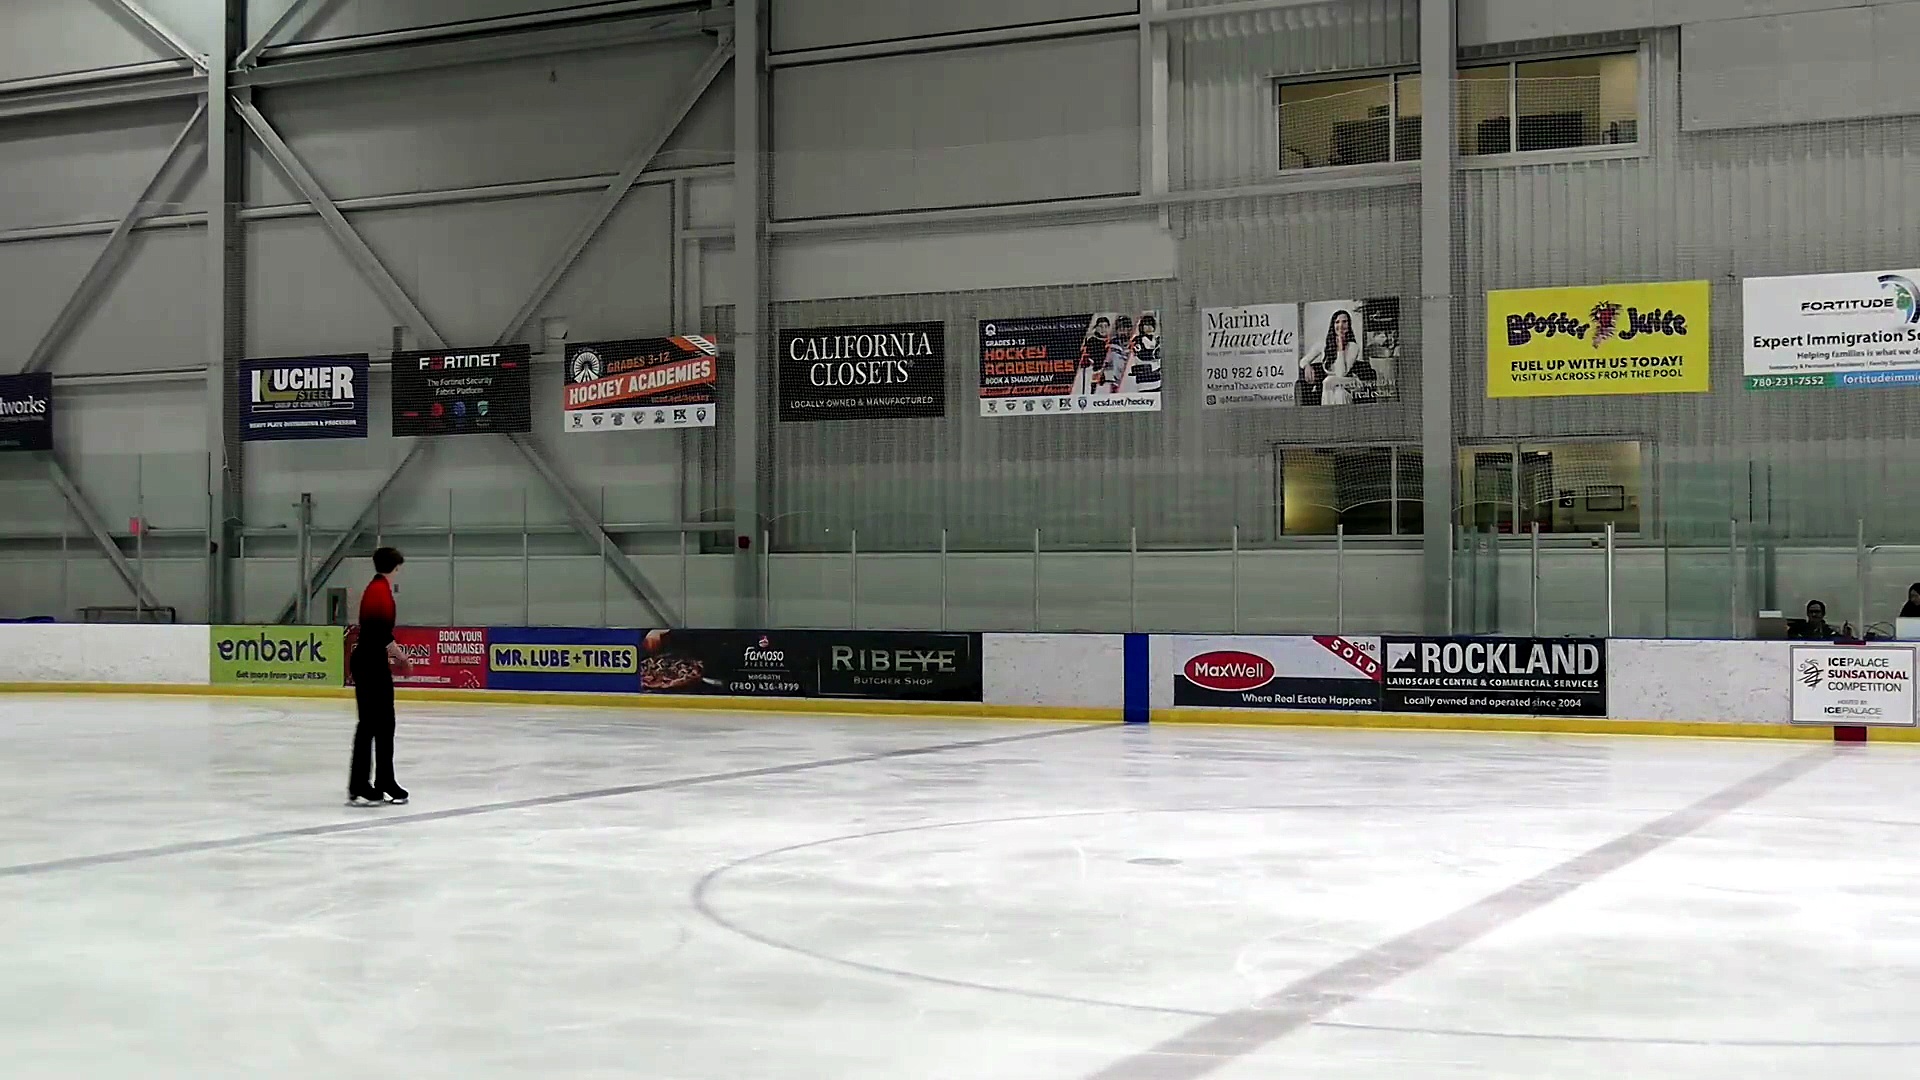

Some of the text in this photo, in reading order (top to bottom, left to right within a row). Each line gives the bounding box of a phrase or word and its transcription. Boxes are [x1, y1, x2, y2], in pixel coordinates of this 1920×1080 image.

[1801, 298, 1894, 311] FORTITUDE
[1208, 310, 1270, 329] Marina
[1507, 307, 1687, 346] Booster Juice
[1208, 329, 1293, 348] Thauvette
[1753, 336, 1803, 349] Expert
[1807, 330, 1903, 346] Immigration
[790, 332, 933, 360] CALIFORNIA
[985, 345, 1048, 360] HOCKEY
[1797, 352, 1829, 360] Helping
[1831, 350, 1865, 358] families
[1876, 348, 1897, 356] what
[419, 353, 501, 370] FORTINET
[607, 351, 671, 373] GRADES 3-12
[985, 360, 1075, 375] ACADEMIES
[1511, 356, 1683, 372] FUEL UP WITH US TODAY!
[1207, 365, 1284, 379] 780 982 6104
[1511, 368, 1683, 382] VISIT US ACROSS FROM THE POOL
[251, 366, 354, 402] KUCHER
[569, 360, 711, 405] HOCKEY ACADEMIES
[986, 376, 1003, 385] BOOK
[1011, 375, 1039, 384] SHADOW
[1040, 374, 1054, 382] DAY
[1752, 374, 1920, 387] 780-231-7552 fortitudeimmi
[298, 390, 331, 400] STEEL
[1093, 397, 1155, 407] ecsd.net/hockey
[791, 400, 824, 409] LOCALLY
[826, 399, 856, 408] OWNED
[866, 396, 933, 406] MANUFACTURED
[439, 631, 482, 642] BOOK YOUR
[217, 632, 327, 662] embark
[437, 643, 484, 654] FUNDRAISER
[1353, 641, 1376, 651] Sale
[441, 655, 447, 663] AT
[495, 648, 527, 666] MR.
[530, 649, 570, 667] LUBE
[582, 650, 632, 668] TIRES
[831, 645, 956, 673] RIBEYE
[1331, 639, 1377, 674] SOLD
[1421, 643, 1599, 675] ROCKLAND
[236, 670, 249, 679] Get
[269, 671, 287, 679] from
[288, 672, 304, 681] your
[1195, 662, 1264, 679] MaxWell
[1828, 670, 1909, 680] SUNSATIONAL
[730, 682, 755, 692] (780)
[1387, 677, 1599, 688] LANDSCAPE CENTRE & COMMERCIAL SERVICES
[1828, 681, 1902, 692] COMPETITION
[1242, 693, 1273, 703] Where
[1274, 693, 1296, 703] Real
[1297, 694, 1327, 704] Estate
[1404, 696, 1581, 708] Locally owned and operated since 2004
